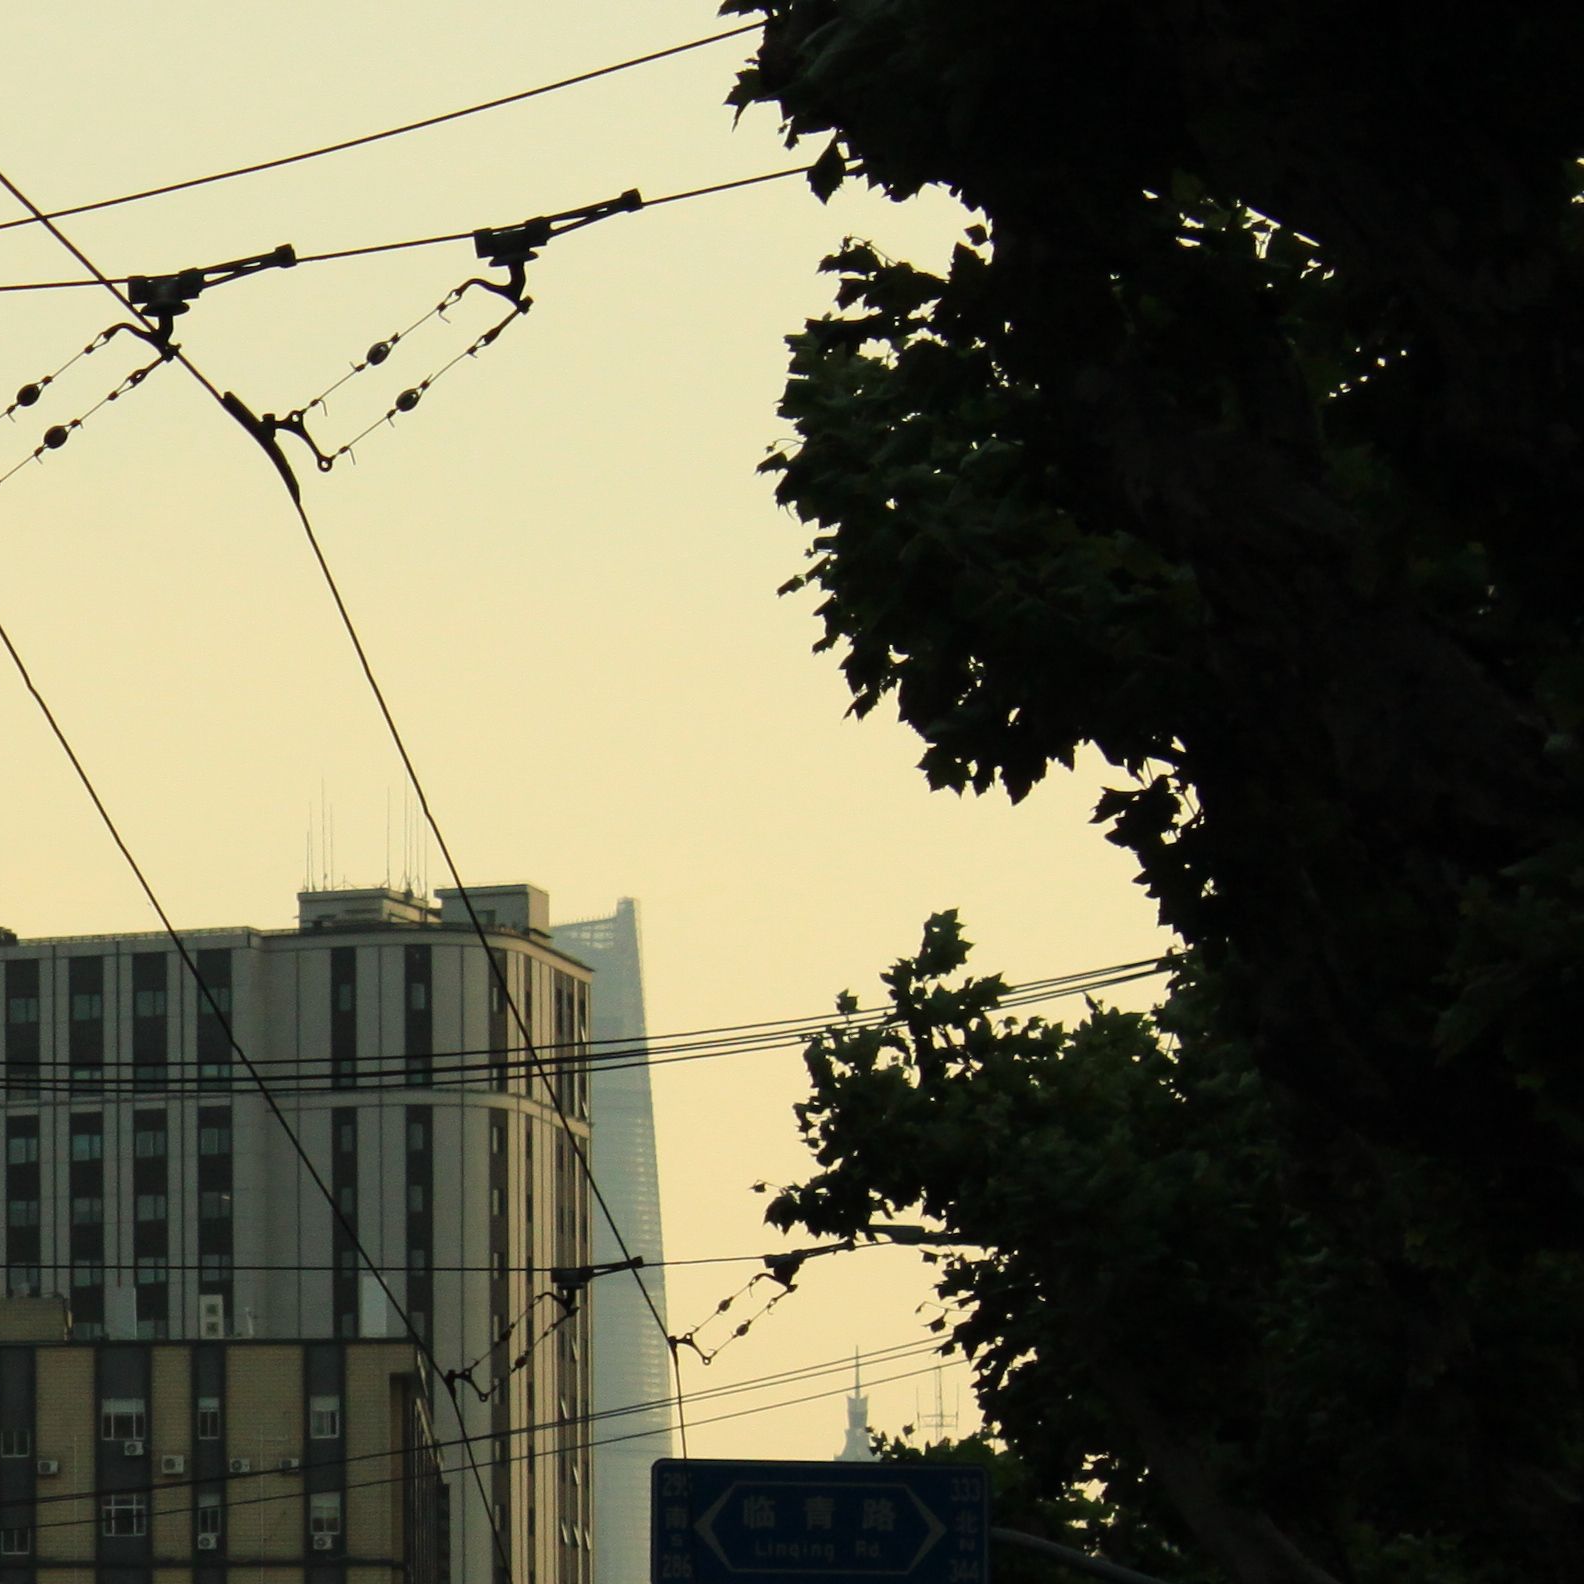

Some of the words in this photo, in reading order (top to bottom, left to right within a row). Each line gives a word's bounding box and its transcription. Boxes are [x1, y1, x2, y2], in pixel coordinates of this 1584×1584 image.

[949, 1477, 981, 1502] 333
[665, 1504, 689, 1530] 南
[742, 1495, 897, 1532] 临青路
[955, 1510, 979, 1535] 北
[754, 1541, 835, 1564] Linqing
[661, 1553, 693, 1579] 286
[947, 1558, 980, 1584] 344
